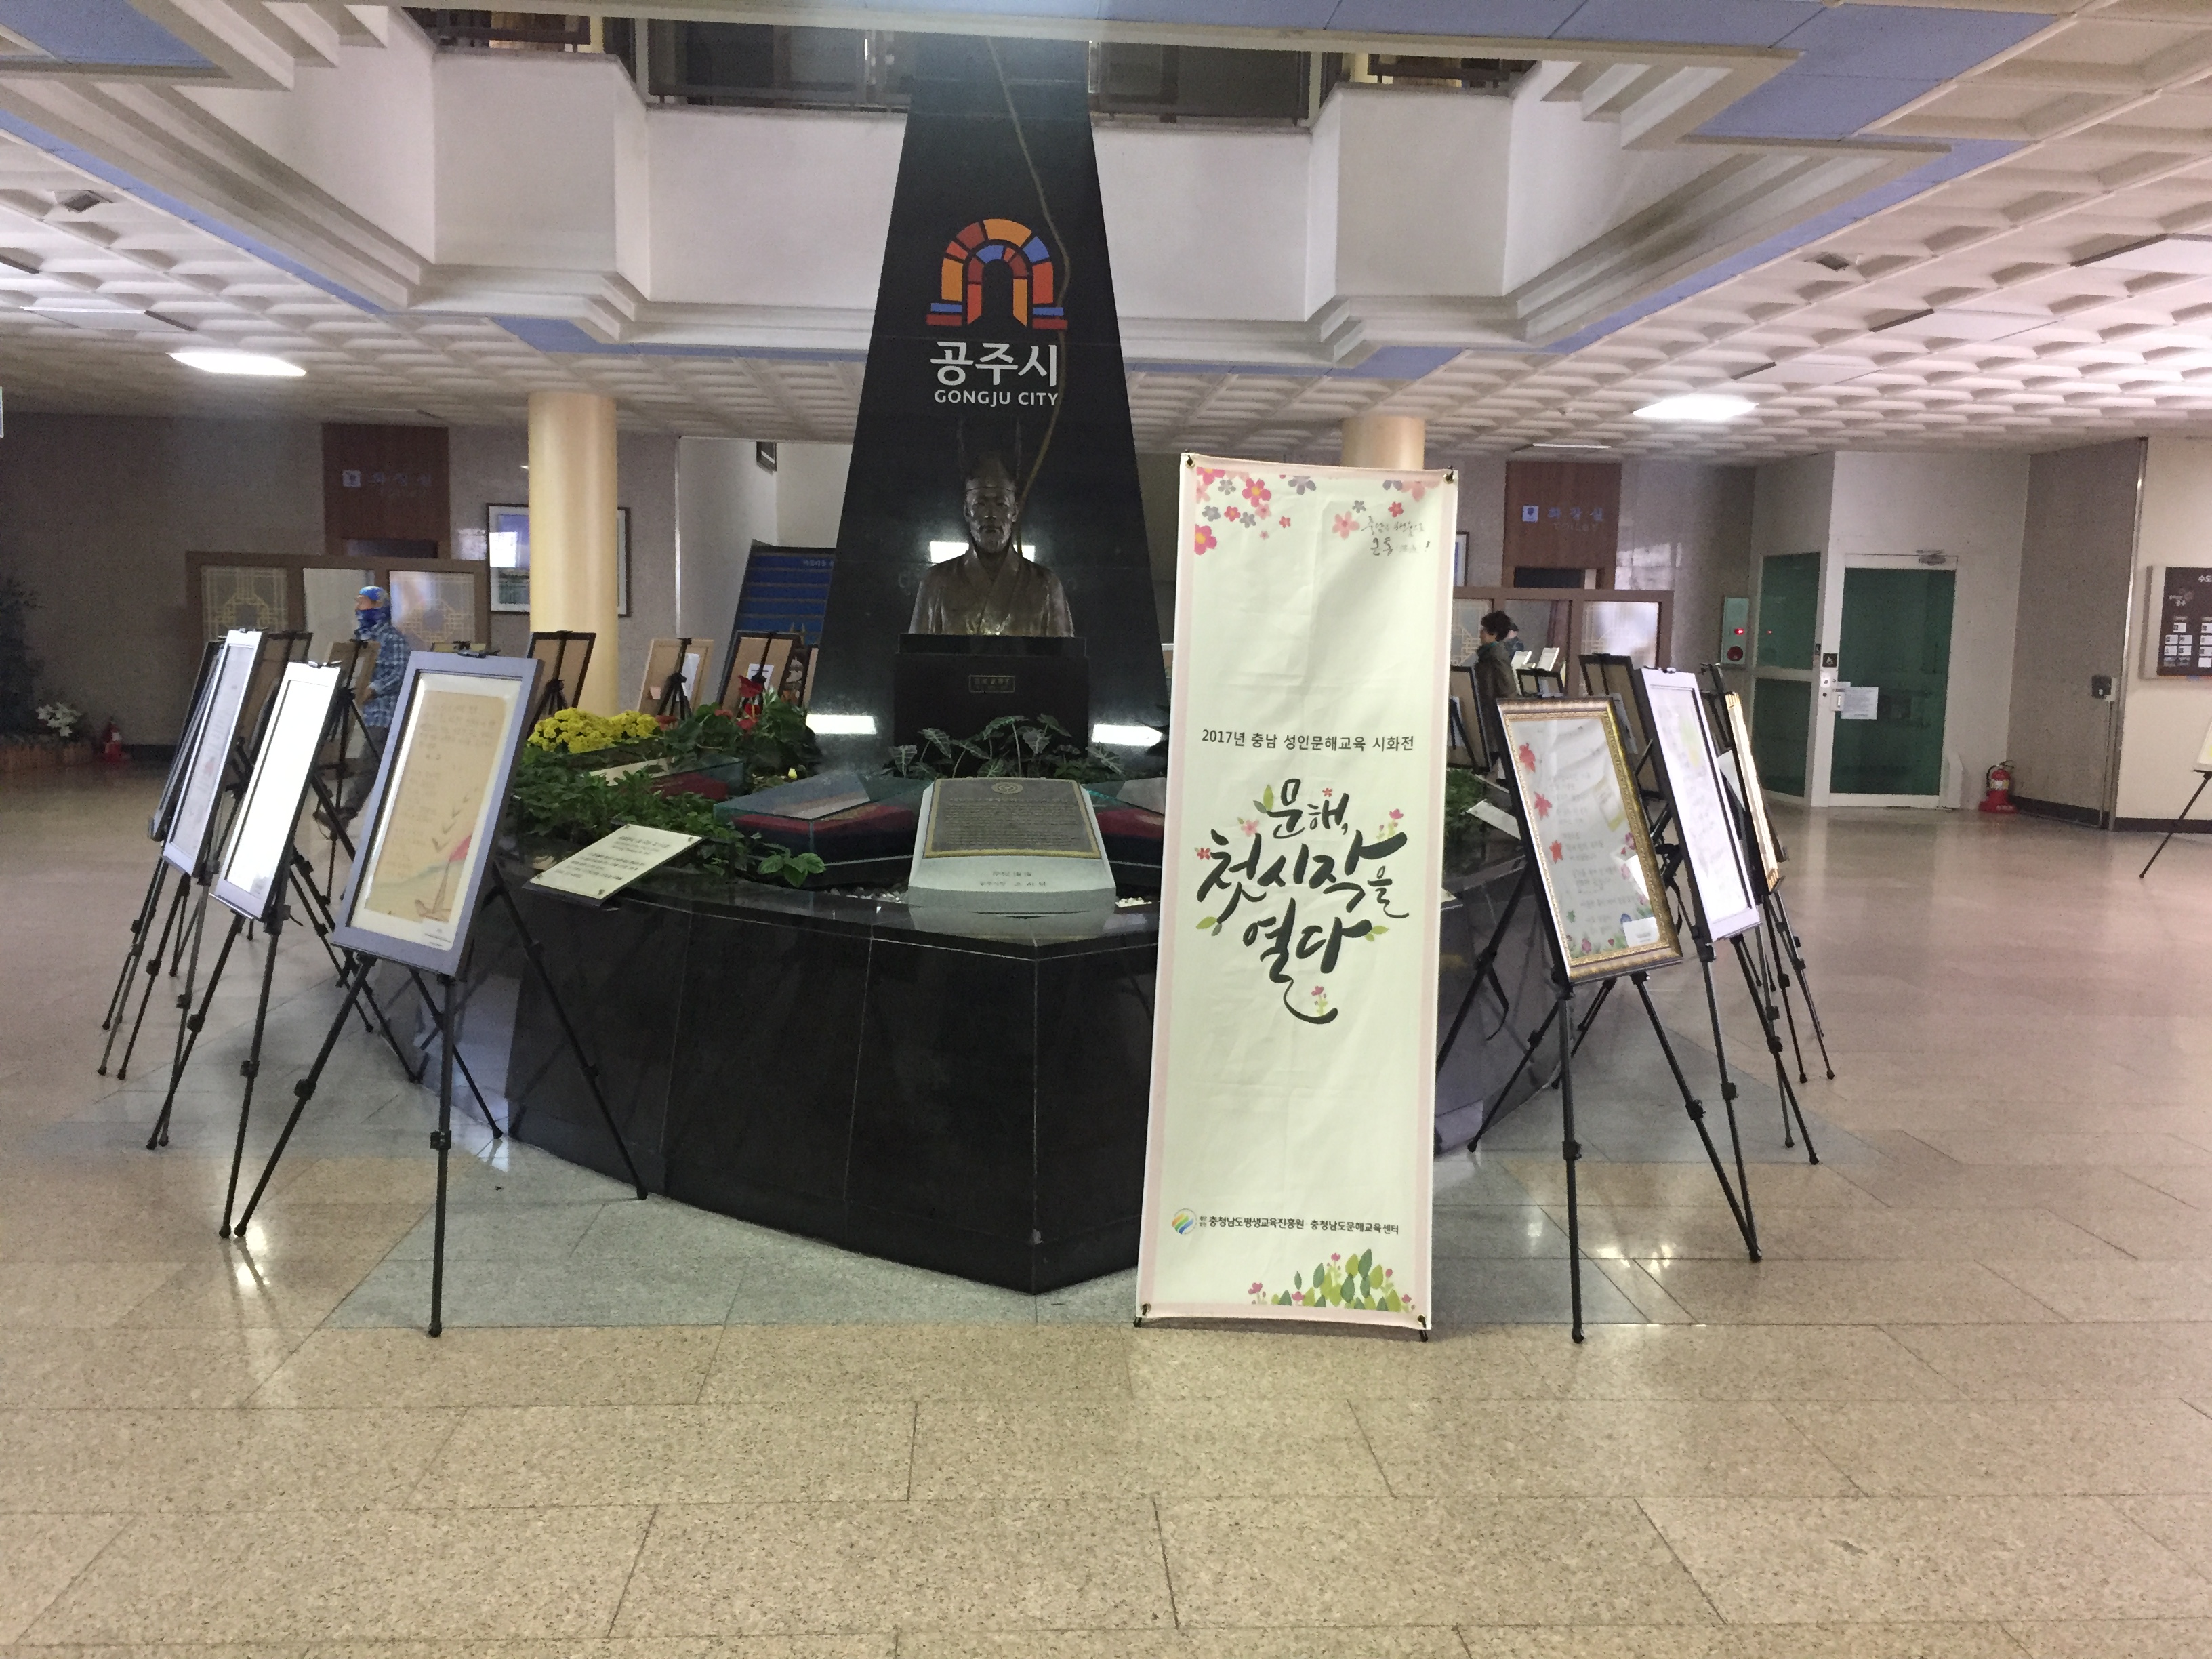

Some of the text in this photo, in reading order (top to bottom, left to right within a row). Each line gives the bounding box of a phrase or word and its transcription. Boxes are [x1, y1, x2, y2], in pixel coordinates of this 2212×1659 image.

[930, 341, 1057, 387] 공주시
[934, 390, 1059, 407] GONGJU CITY
[1202, 729, 1414, 752] 2017년 충남 성인문해교육 시화전
[1243, 897, 1373, 1025] 열다
[1311, 1219, 1399, 1235] 충청남도문해교육센터
